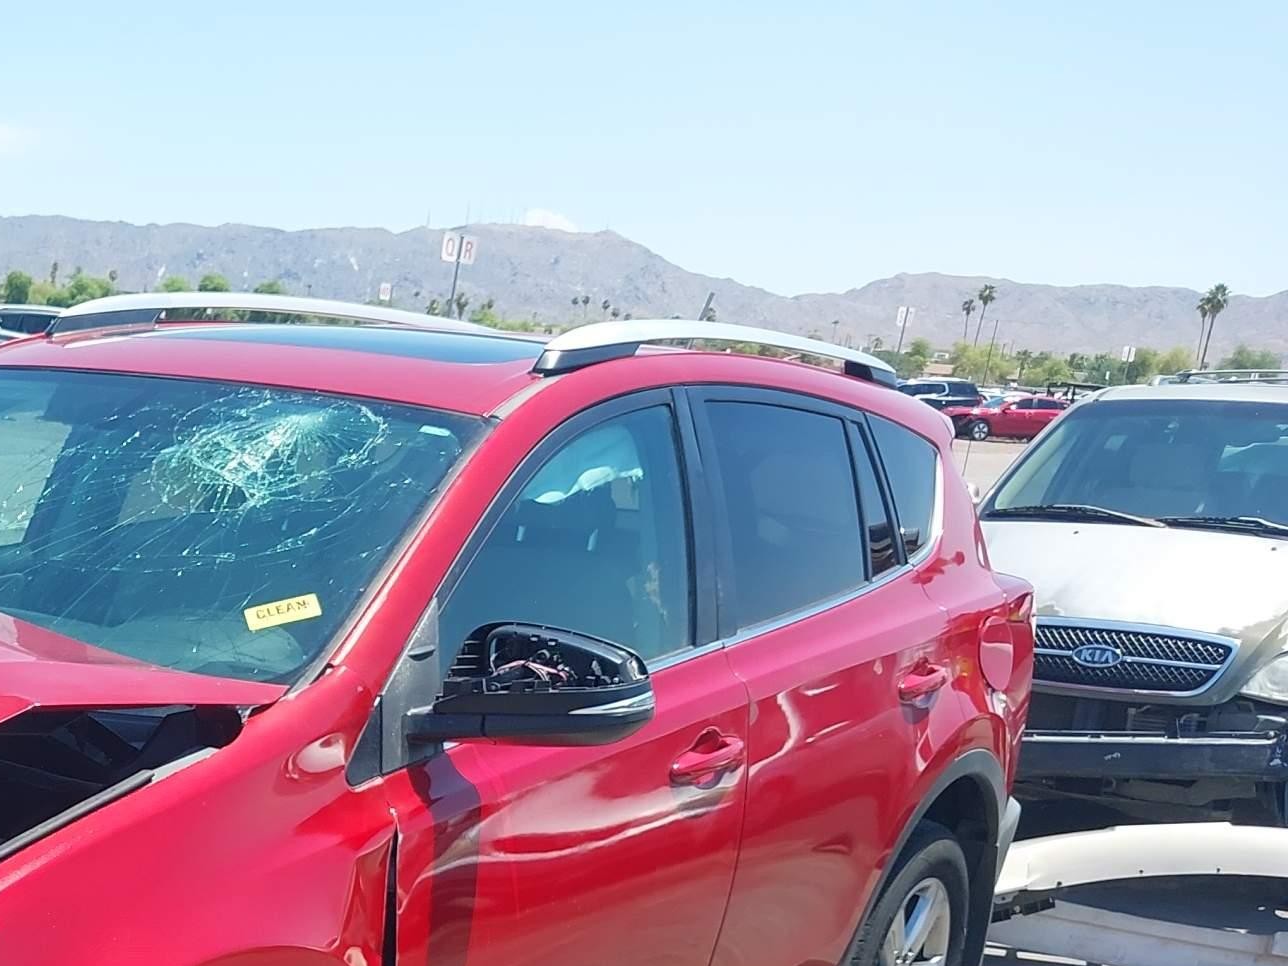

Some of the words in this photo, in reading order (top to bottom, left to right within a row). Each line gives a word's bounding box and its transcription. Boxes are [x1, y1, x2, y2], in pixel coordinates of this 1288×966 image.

[463, 241, 473, 260] R
[256, 600, 309, 619] CLEAN
[1080, 649, 1113, 664] KIA
